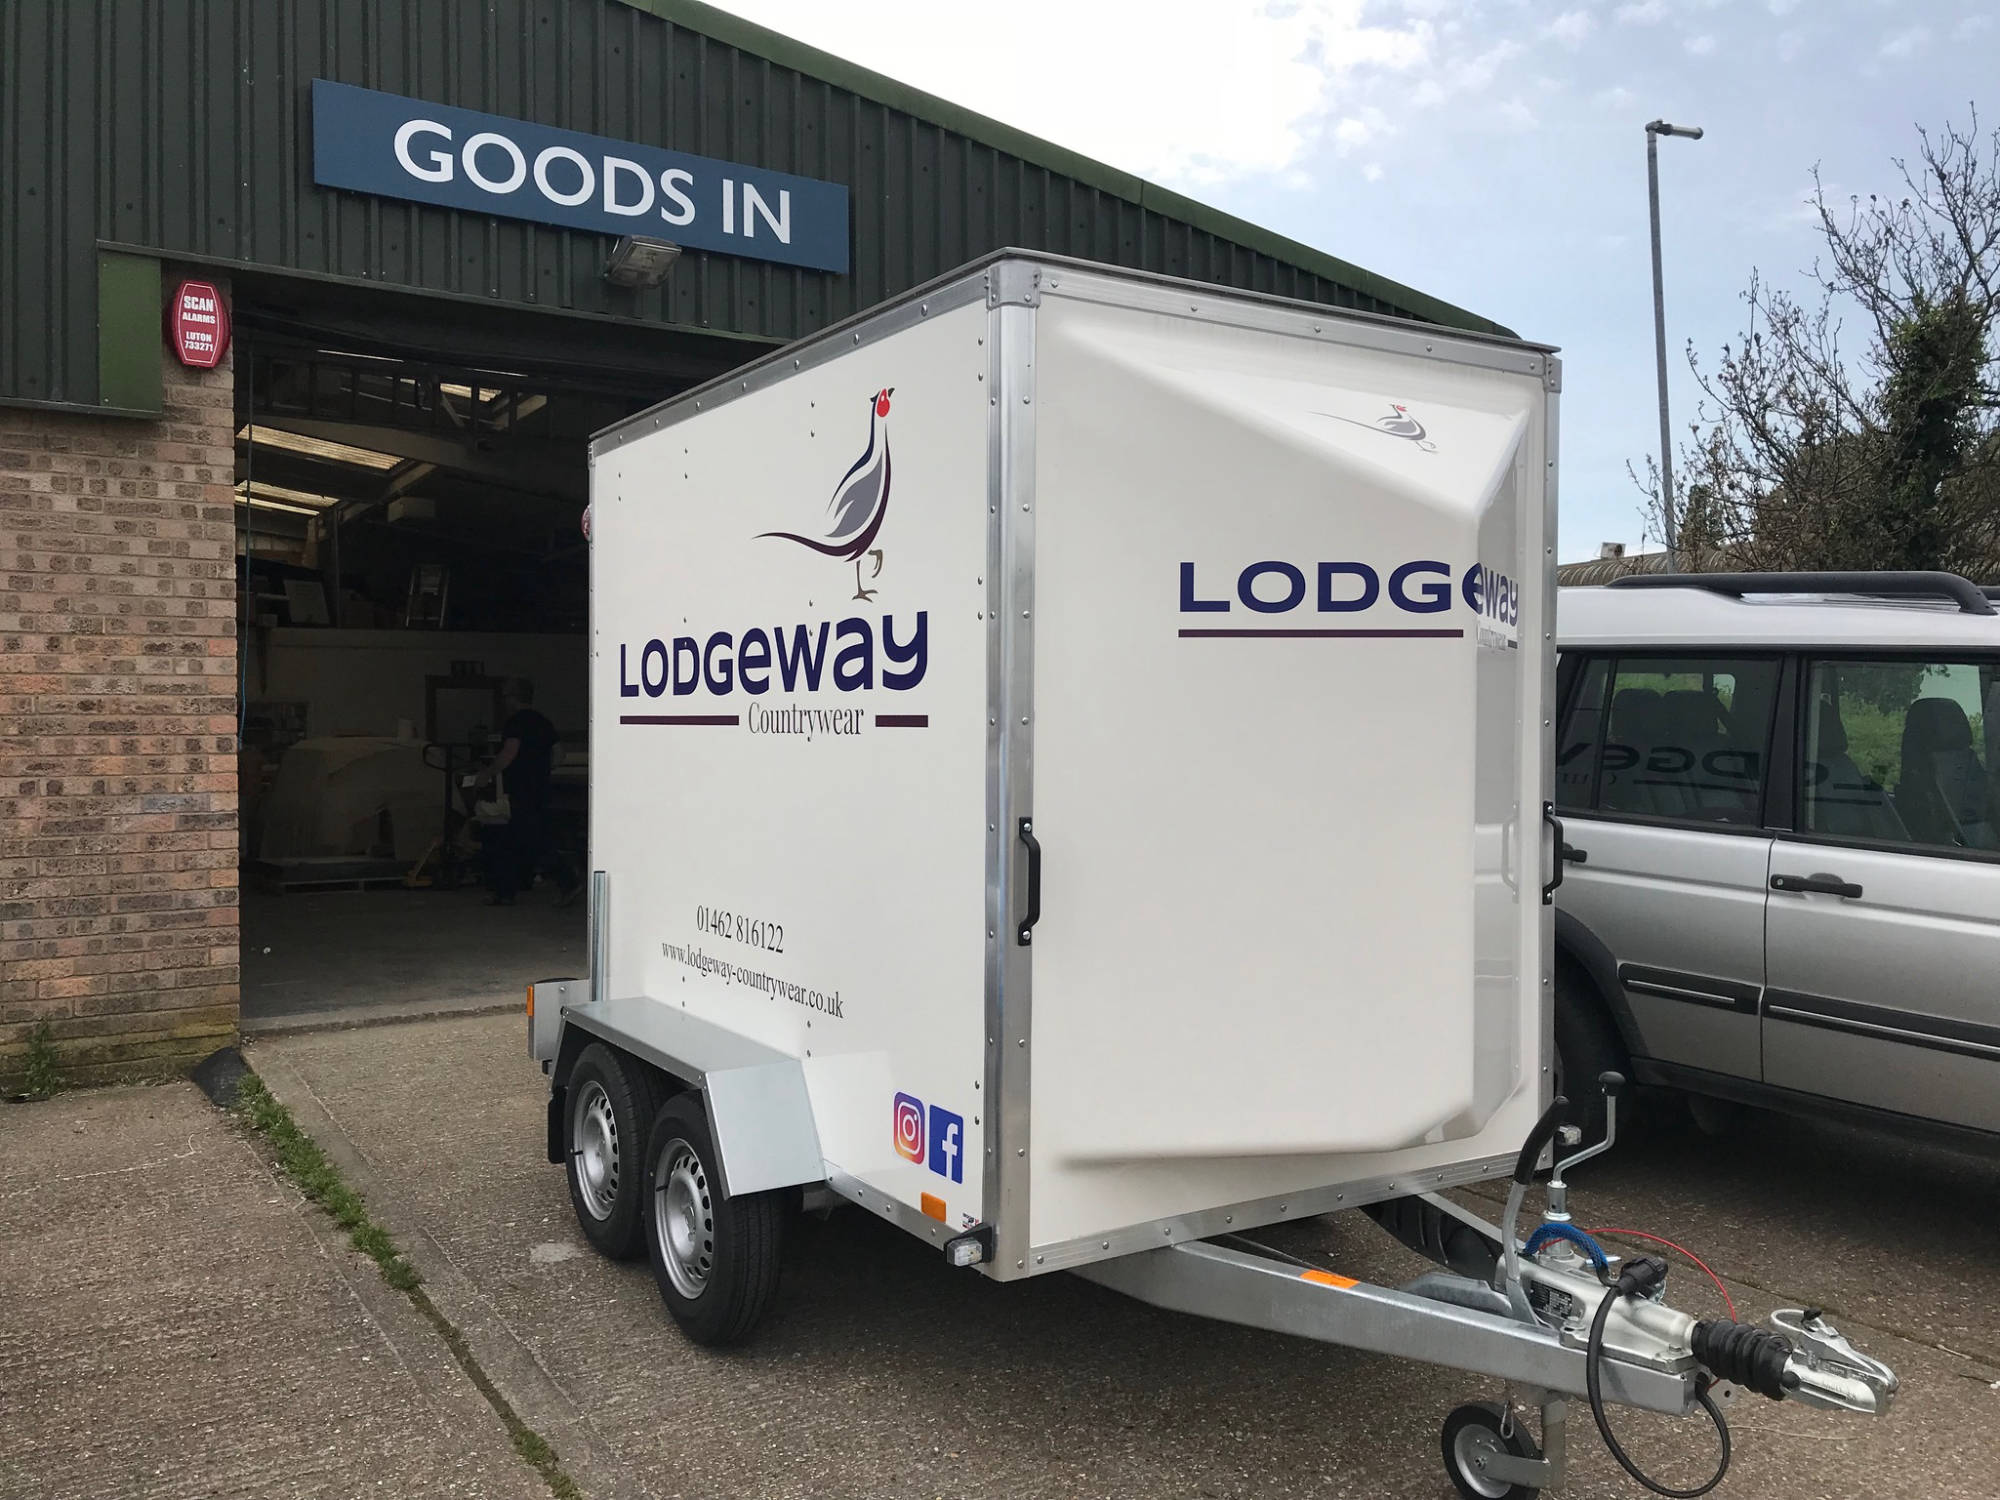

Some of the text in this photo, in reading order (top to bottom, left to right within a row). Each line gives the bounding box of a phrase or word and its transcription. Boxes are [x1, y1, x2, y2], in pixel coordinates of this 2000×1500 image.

[393, 119, 791, 245] GOODS IN
[182, 312, 216, 324] ALARMS
[183, 295, 214, 312] SCAN
[184, 340, 214, 352] 733271
[185, 331, 212, 342] LUTON
[748, 701, 864, 742] Countrywear
[696, 904, 784, 954] 01462 816122
[661, 942, 844, 1019] www.lodgeway-countrywear.co.uk
